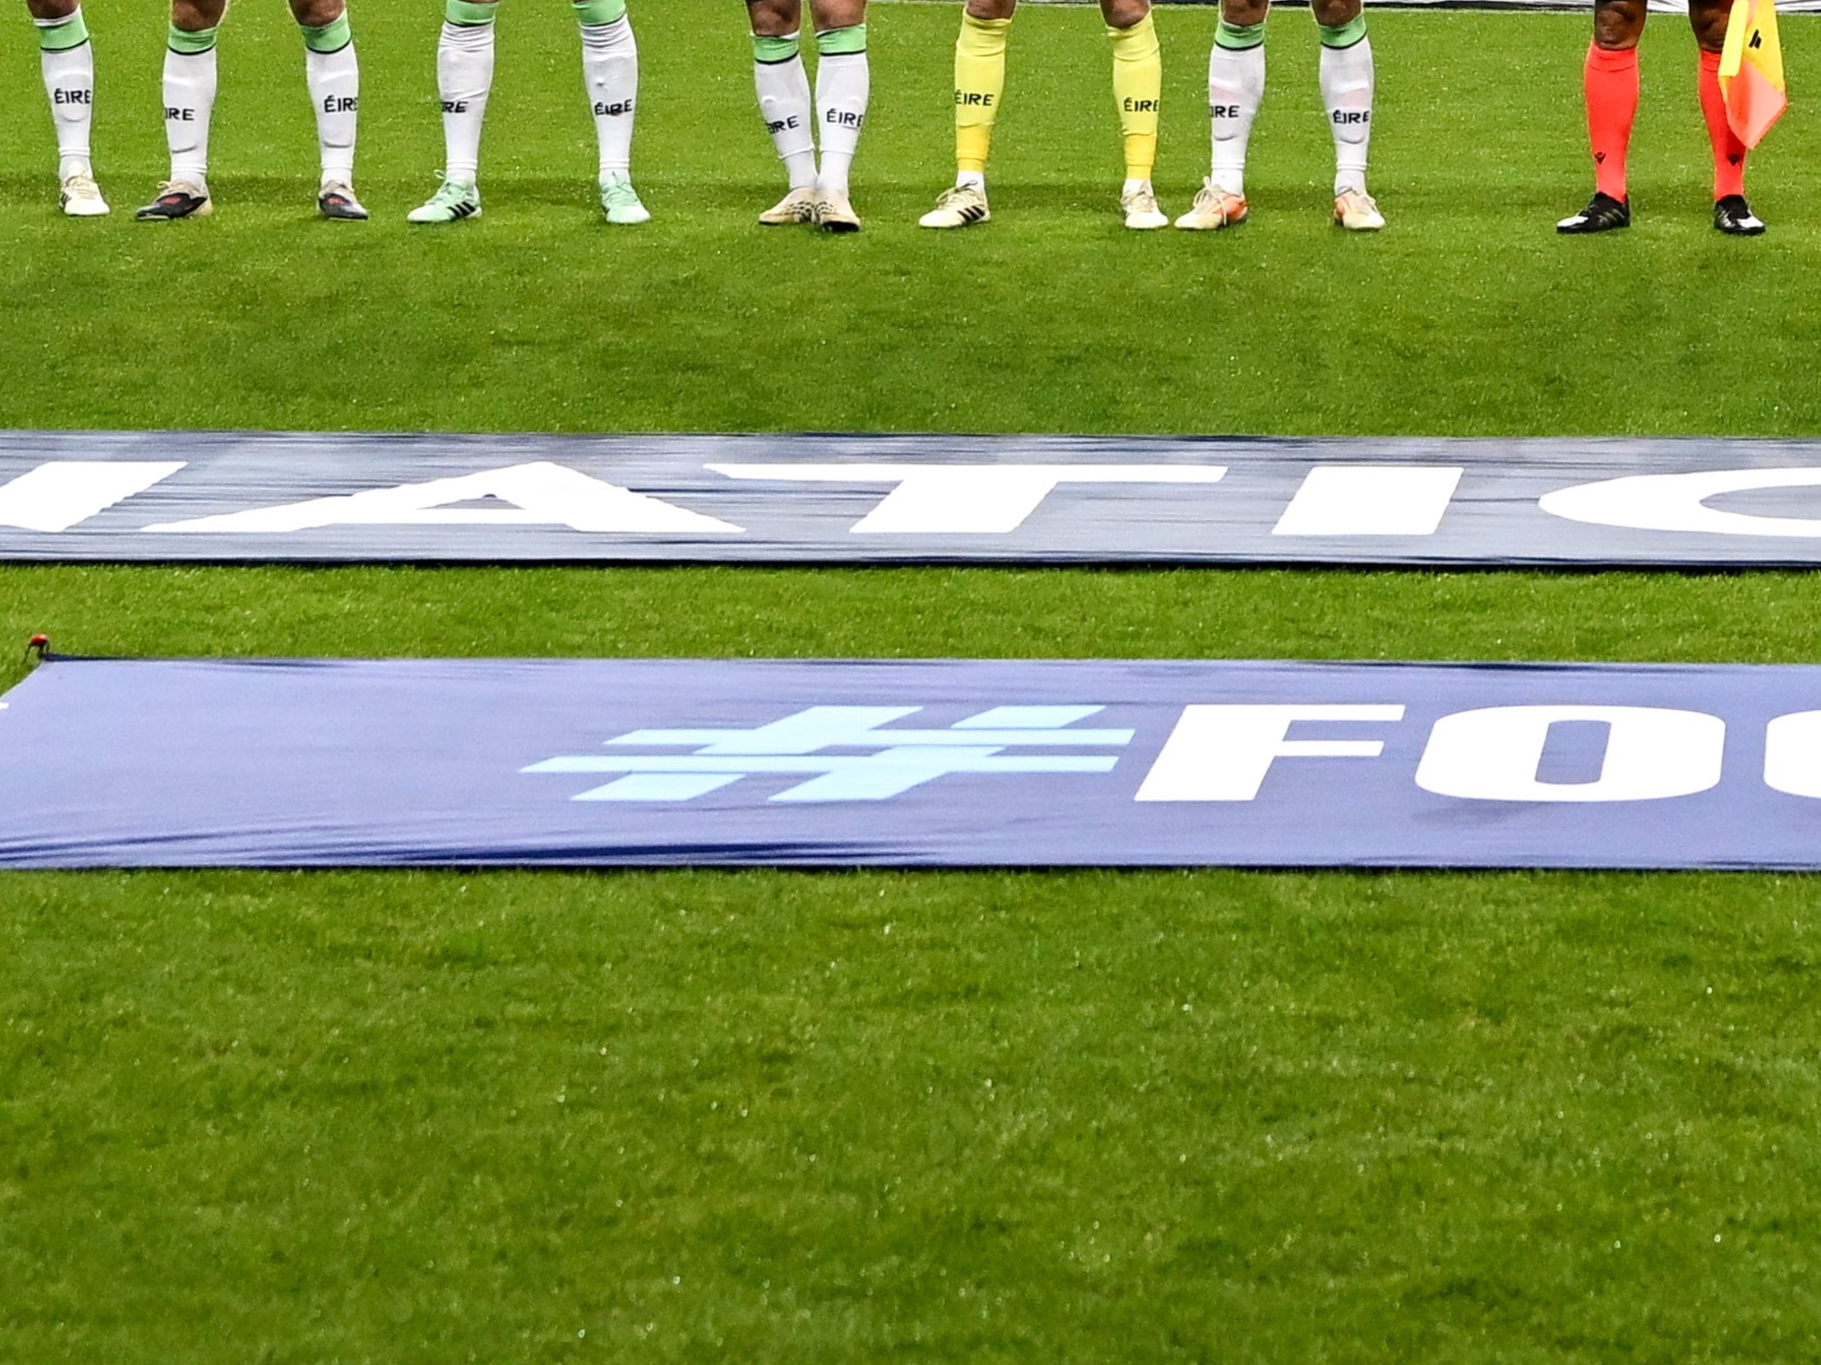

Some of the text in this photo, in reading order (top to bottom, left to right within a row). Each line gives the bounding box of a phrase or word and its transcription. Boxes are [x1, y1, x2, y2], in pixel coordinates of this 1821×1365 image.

[442, 101, 469, 113] RE
[1211, 104, 1240, 118] IRE
[165, 108, 195, 121] IRE
